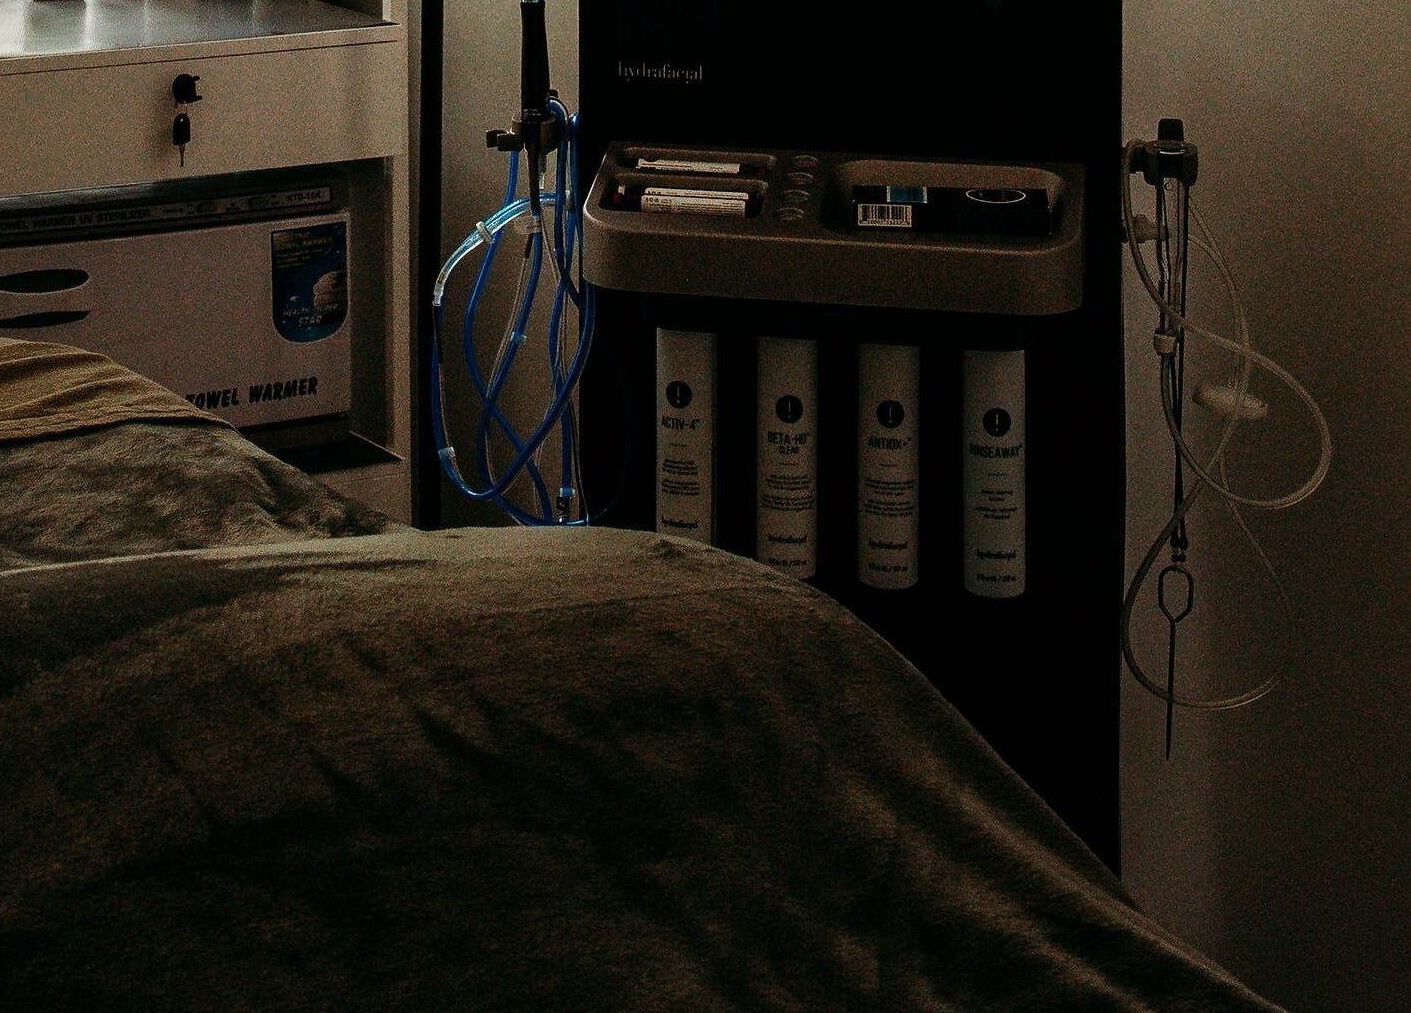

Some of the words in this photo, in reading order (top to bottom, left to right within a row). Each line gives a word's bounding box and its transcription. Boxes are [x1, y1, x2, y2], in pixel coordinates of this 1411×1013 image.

[618, 60, 703, 84] hydrafacial
[32, 215, 77, 229] WARMER
[185, 387, 240, 410] TOWEL
[249, 376, 319, 404] WARMER
